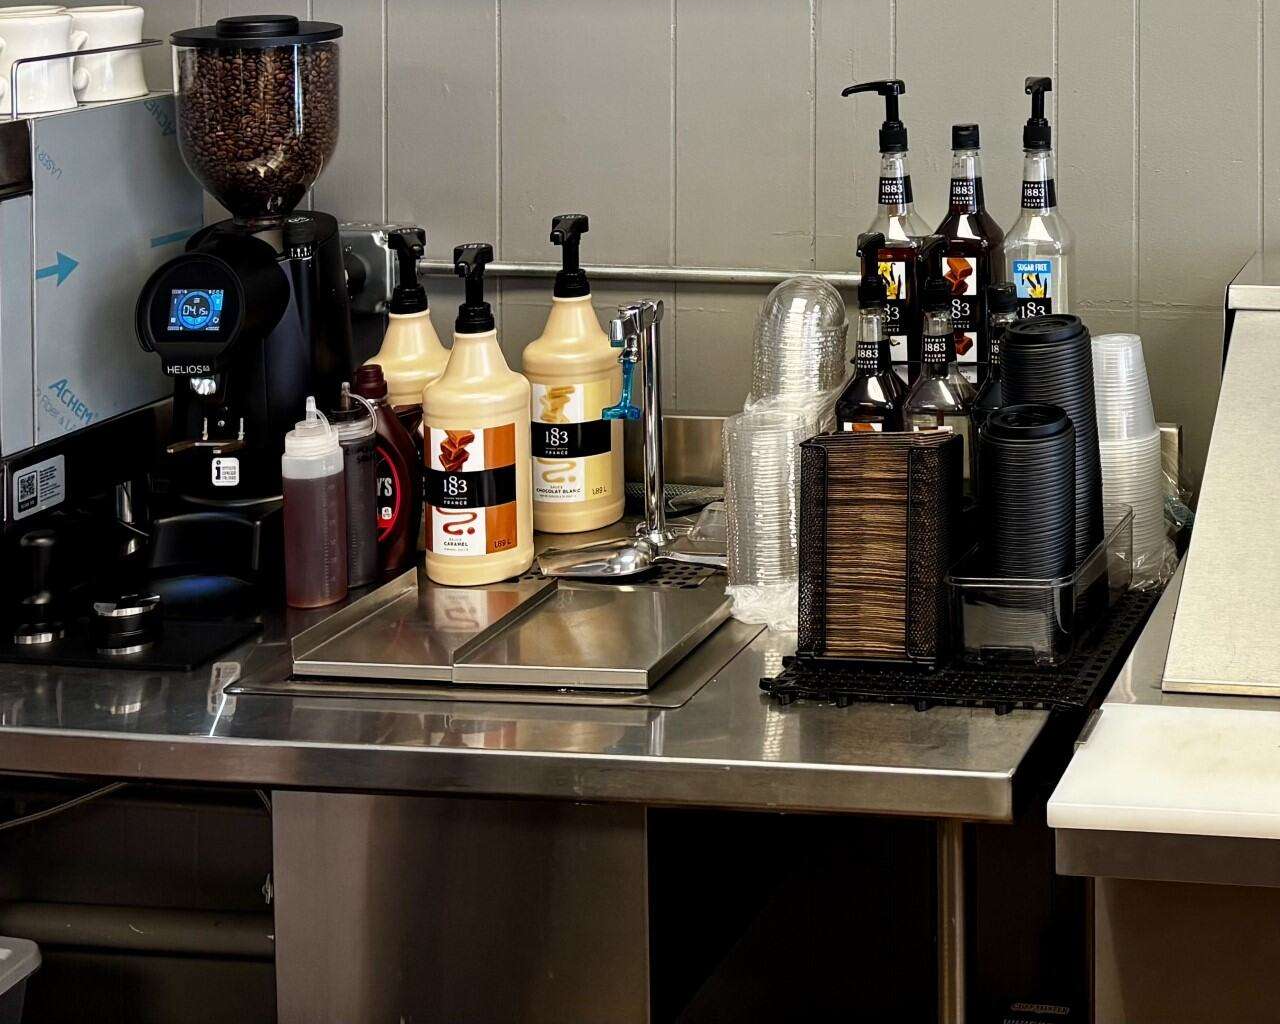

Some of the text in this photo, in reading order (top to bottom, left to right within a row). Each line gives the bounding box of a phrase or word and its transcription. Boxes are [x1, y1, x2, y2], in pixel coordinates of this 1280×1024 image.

[882, 184, 902, 193] 1883
[953, 186, 973, 195] 1883
[1024, 188, 1044, 197] 1883
[1017, 263, 1047, 272] SUGAR FREE
[925, 342, 945, 351] 1883
[857, 349, 878, 358] 1883
[167, 365, 203, 374] HELIOS
